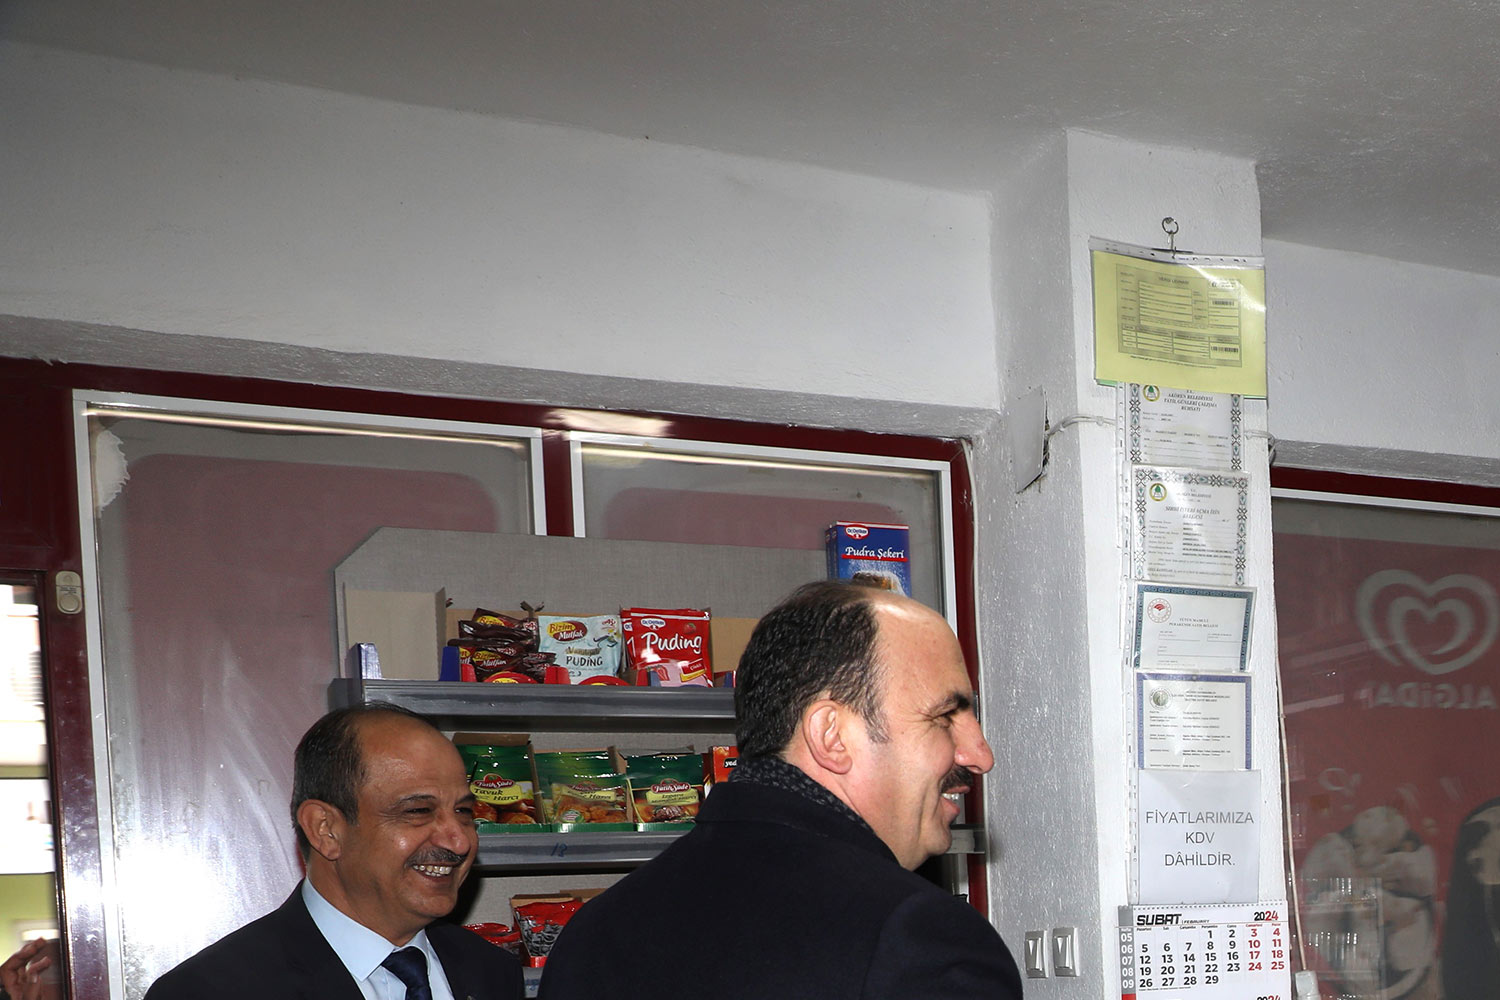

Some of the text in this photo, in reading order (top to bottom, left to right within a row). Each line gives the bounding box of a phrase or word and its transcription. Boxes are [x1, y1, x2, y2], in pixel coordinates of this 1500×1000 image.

[845, 545, 906, 560] Pudra Şekeri
[558, 630, 584, 641] Mutfak
[641, 632, 702, 654] Puding
[1145, 810, 1255, 825] FİYATLARIMIZA
[1185, 831, 1215, 844] KDV
[1254, 911, 1278, 921] 2024
[1208, 928, 1280, 938] 1 2 3 4
[1142, 939, 1281, 952] 5 6 7 8 9 10 11
